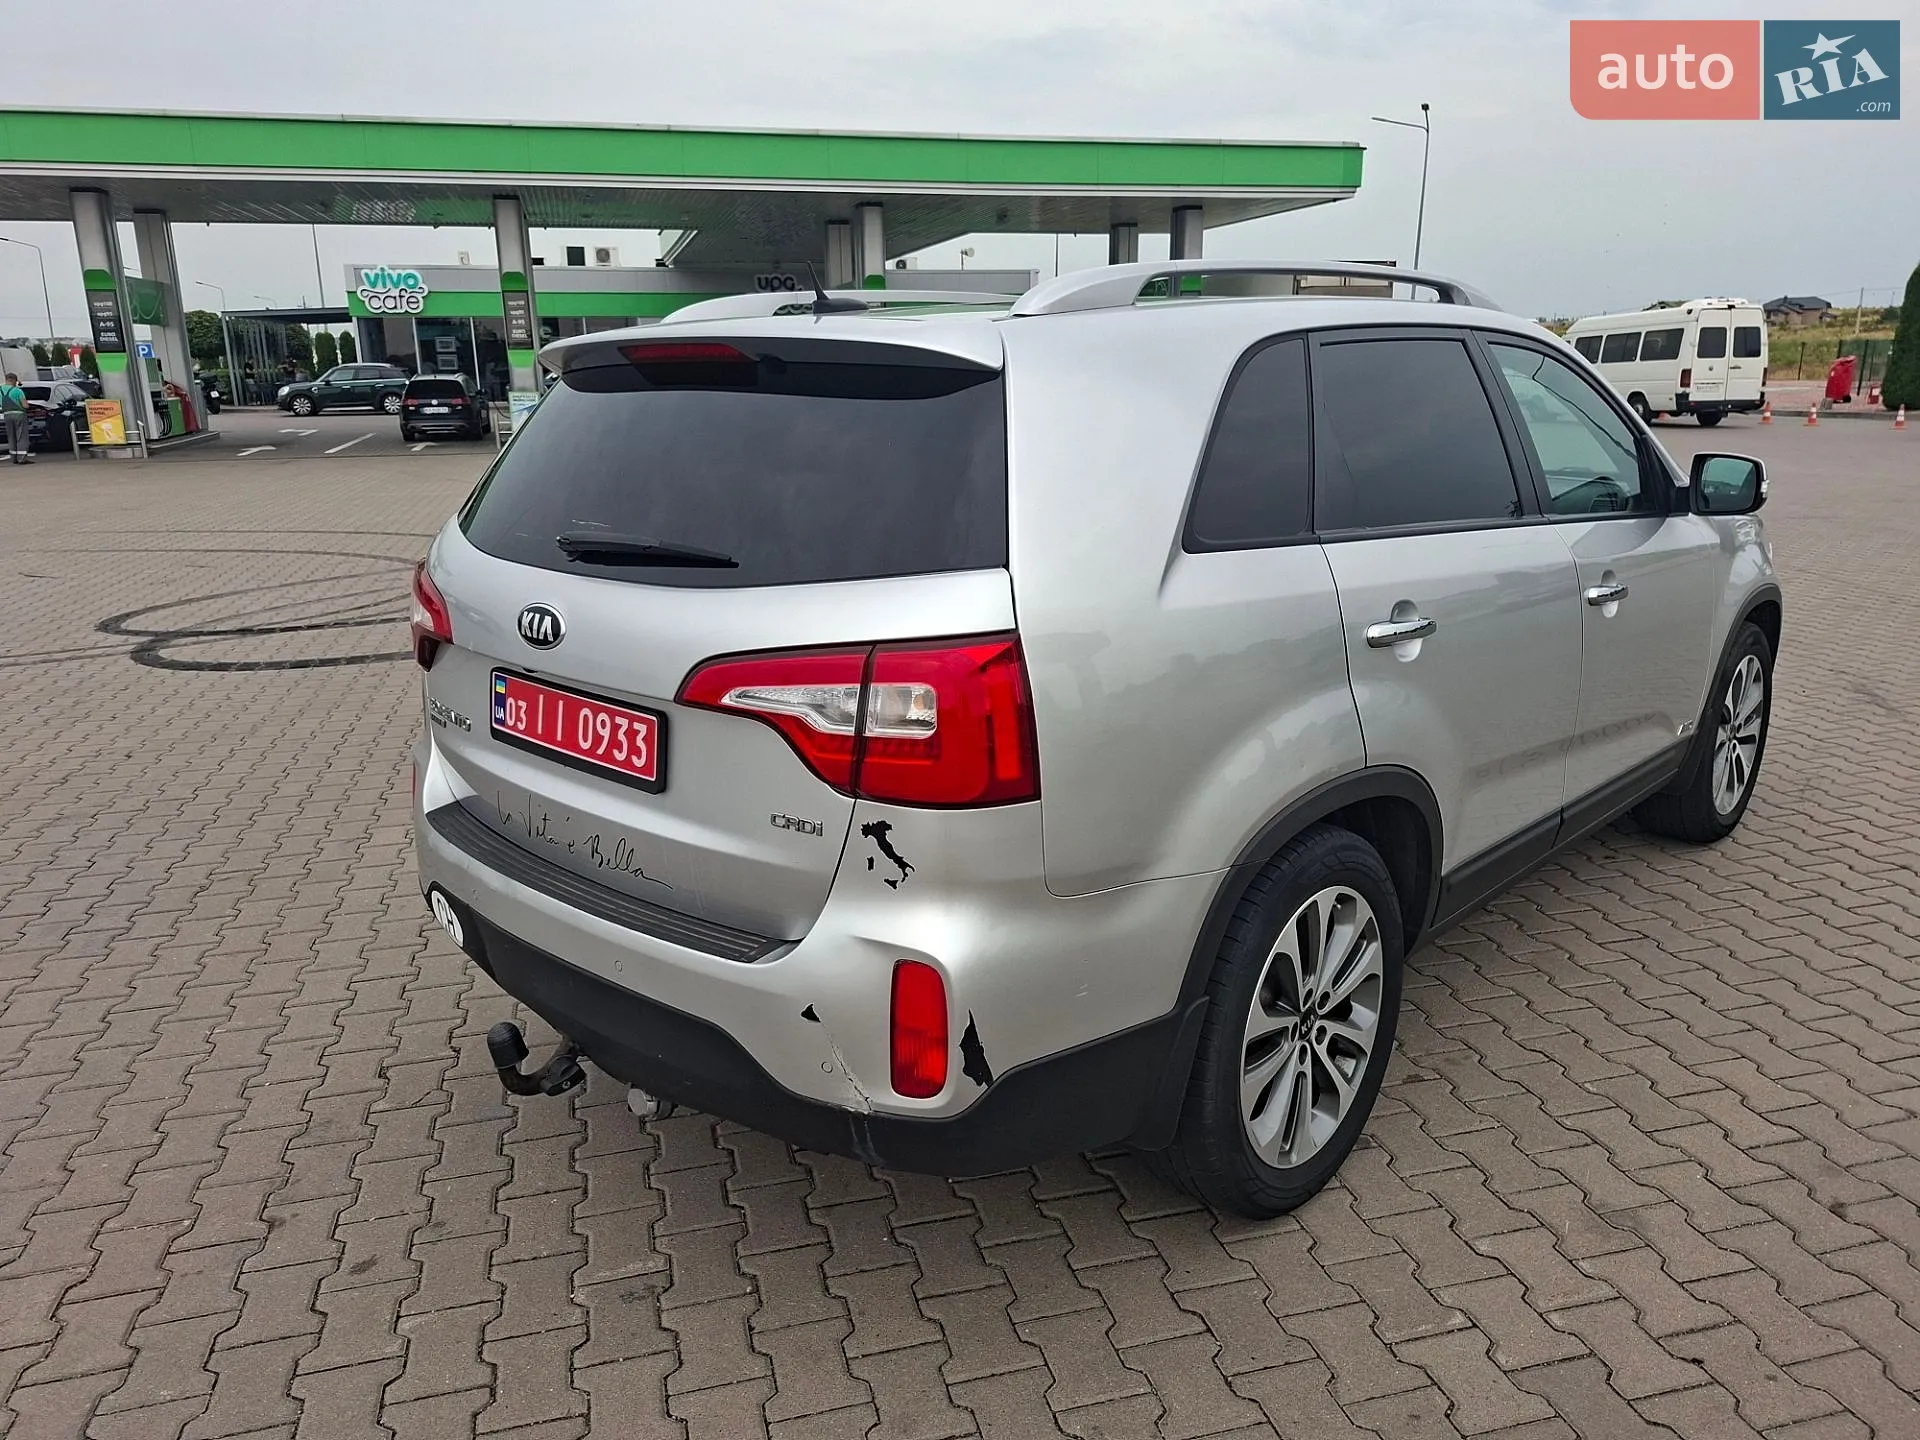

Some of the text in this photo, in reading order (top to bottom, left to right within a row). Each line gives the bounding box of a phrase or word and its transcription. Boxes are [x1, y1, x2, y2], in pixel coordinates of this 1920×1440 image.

[363, 266, 419, 290] vivo
[138, 345, 149, 359] P
[520, 610, 554, 641] KIA
[495, 705, 505, 721] UA
[770, 811, 824, 837] CRDi
[583, 834, 674, 890] Bella
